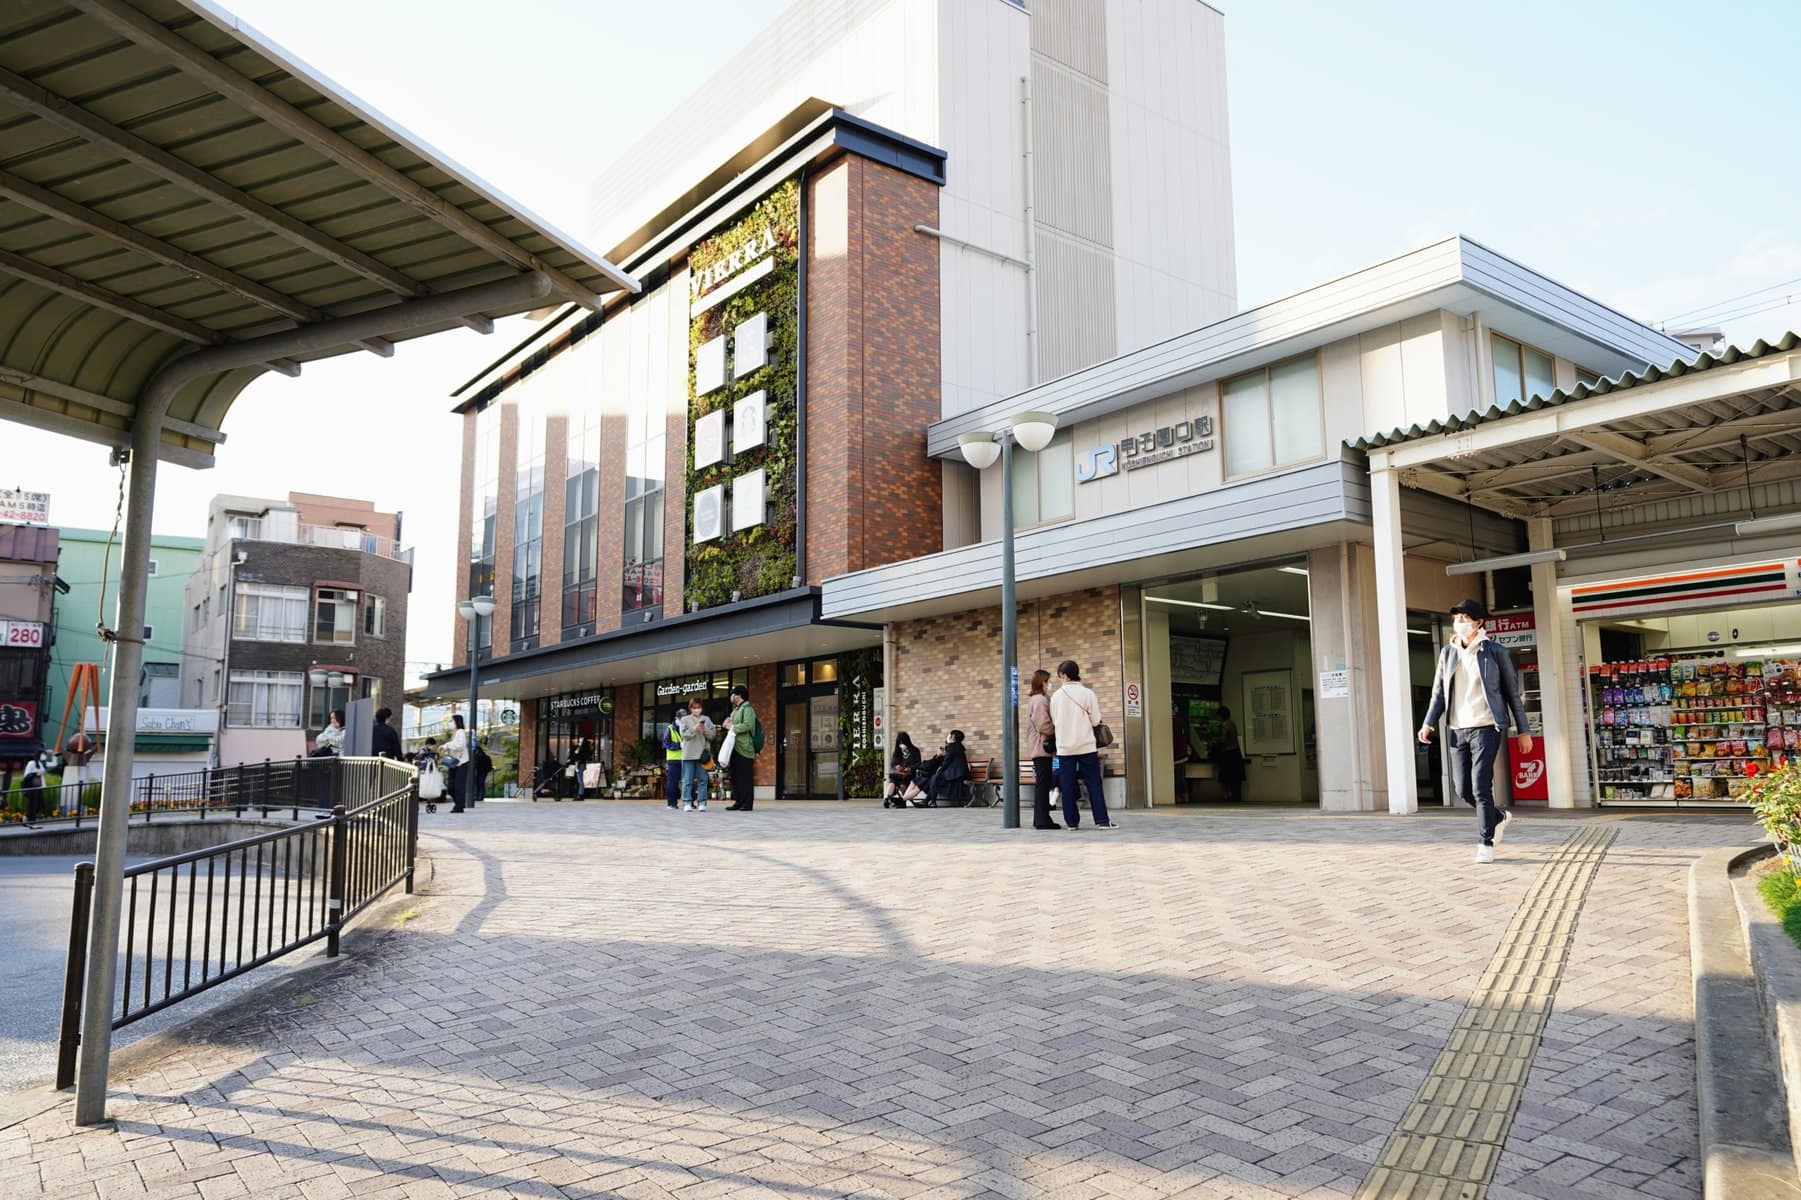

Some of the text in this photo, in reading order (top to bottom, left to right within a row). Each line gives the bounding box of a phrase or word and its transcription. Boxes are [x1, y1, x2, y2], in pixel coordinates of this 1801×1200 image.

[690, 226, 777, 296] VIERRA
[1076, 416, 1211, 481] JR 甲子園口駅
[11, 628, 40, 643] 280
[657, 680, 707, 695] Garden-garden
[551, 698, 580, 710] STARBUCKS
